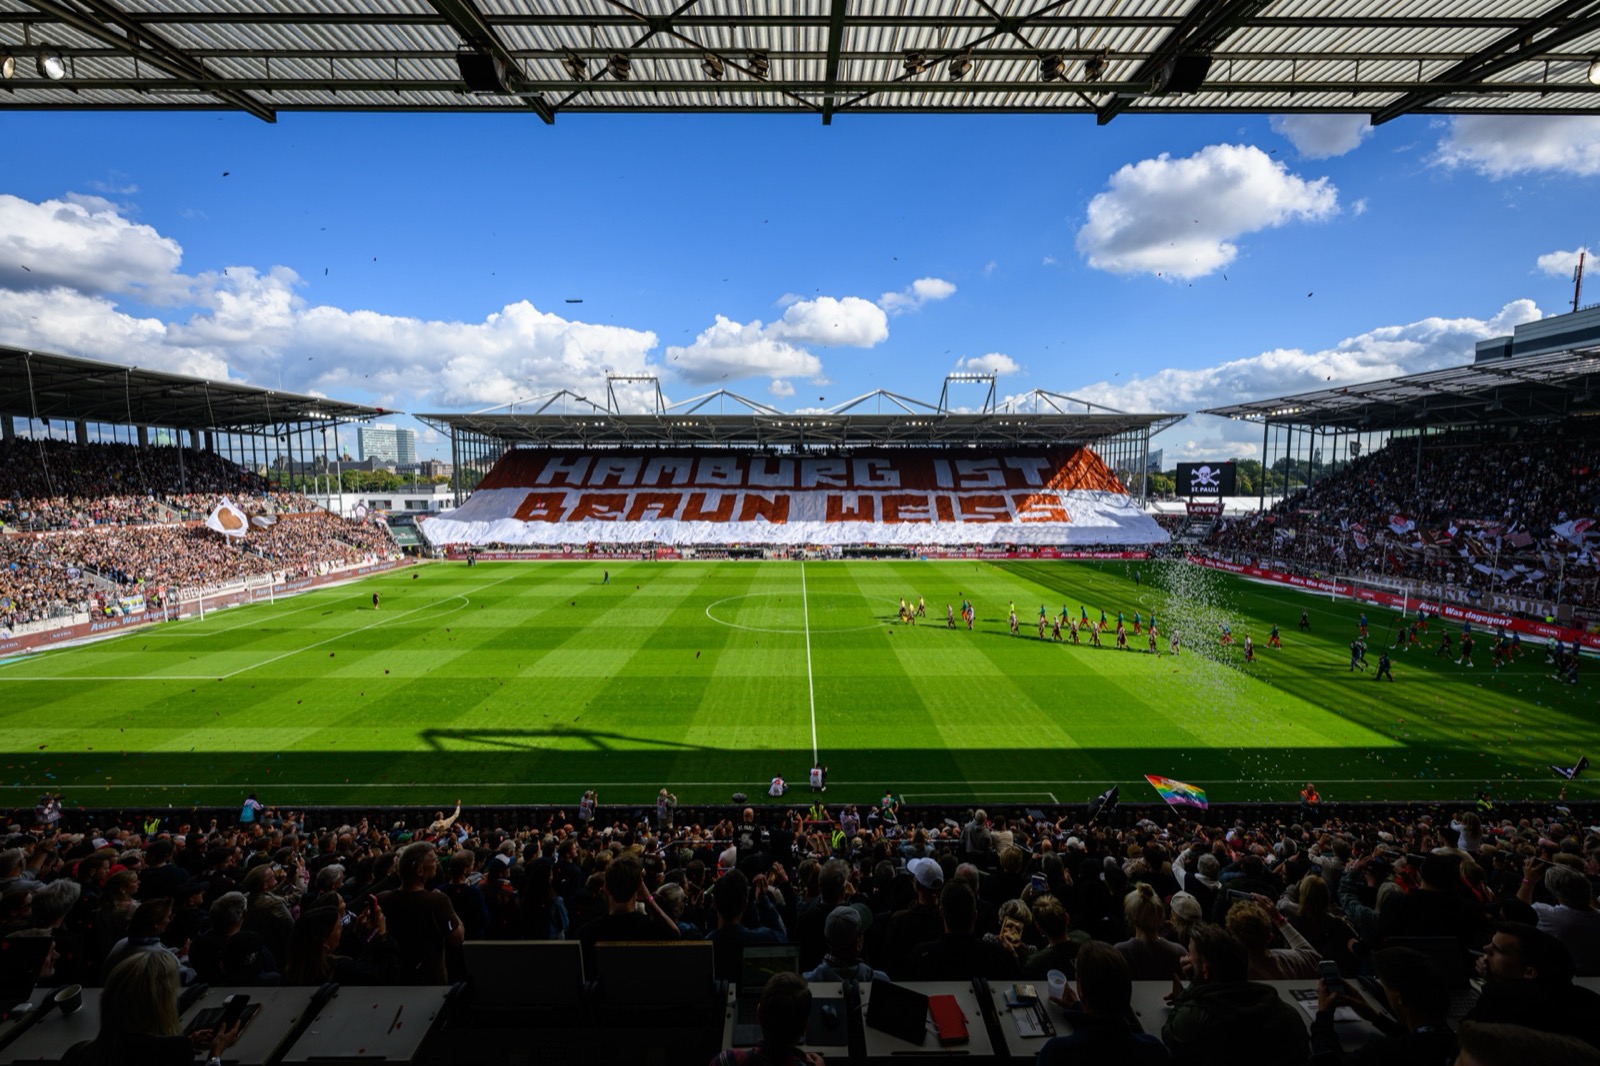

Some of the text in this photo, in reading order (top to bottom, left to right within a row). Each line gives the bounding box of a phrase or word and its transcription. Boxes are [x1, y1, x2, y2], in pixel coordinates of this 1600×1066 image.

[535, 456, 1050, 488] HAMBURG IST
[512, 491, 1071, 525] BRAUN WEISS
[1445, 607, 1464, 618] Was
[1465, 610, 1513, 626] dagegen?
[1493, 596, 1559, 619] PAULI
[91, 621, 119, 632] Astra.
[122, 615, 141, 625] Was
[1538, 626, 1559, 636] ASTRA
